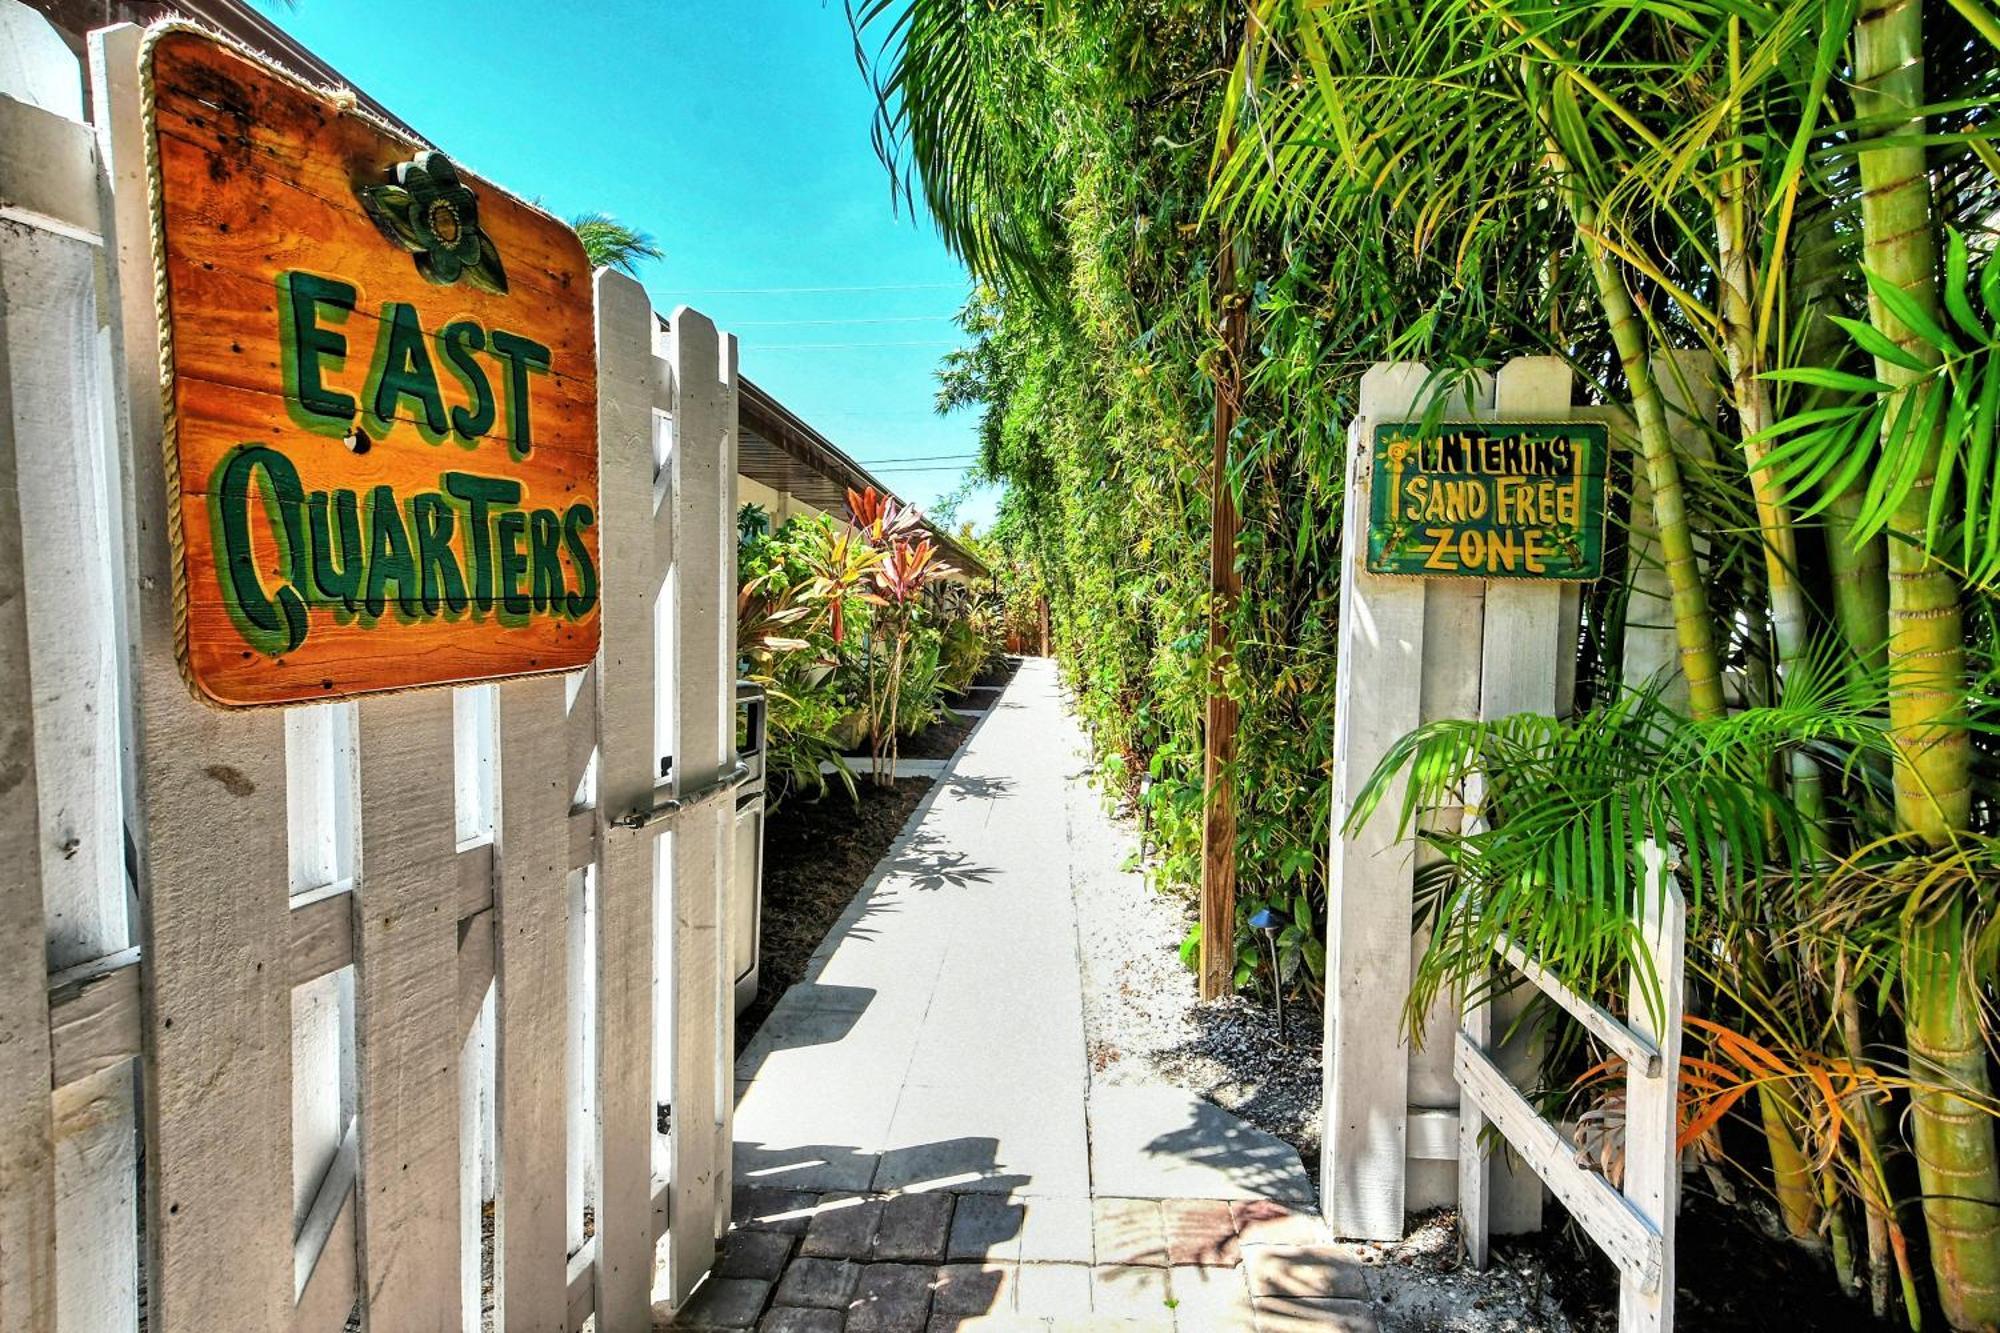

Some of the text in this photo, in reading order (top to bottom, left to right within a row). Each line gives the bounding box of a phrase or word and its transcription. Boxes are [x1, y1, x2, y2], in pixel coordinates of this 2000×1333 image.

[277, 270, 553, 461] EAST
[208, 443, 598, 656] QUARTERS
[1404, 475, 1575, 527] SAND FREE
[1424, 528, 1546, 573] ZONE
